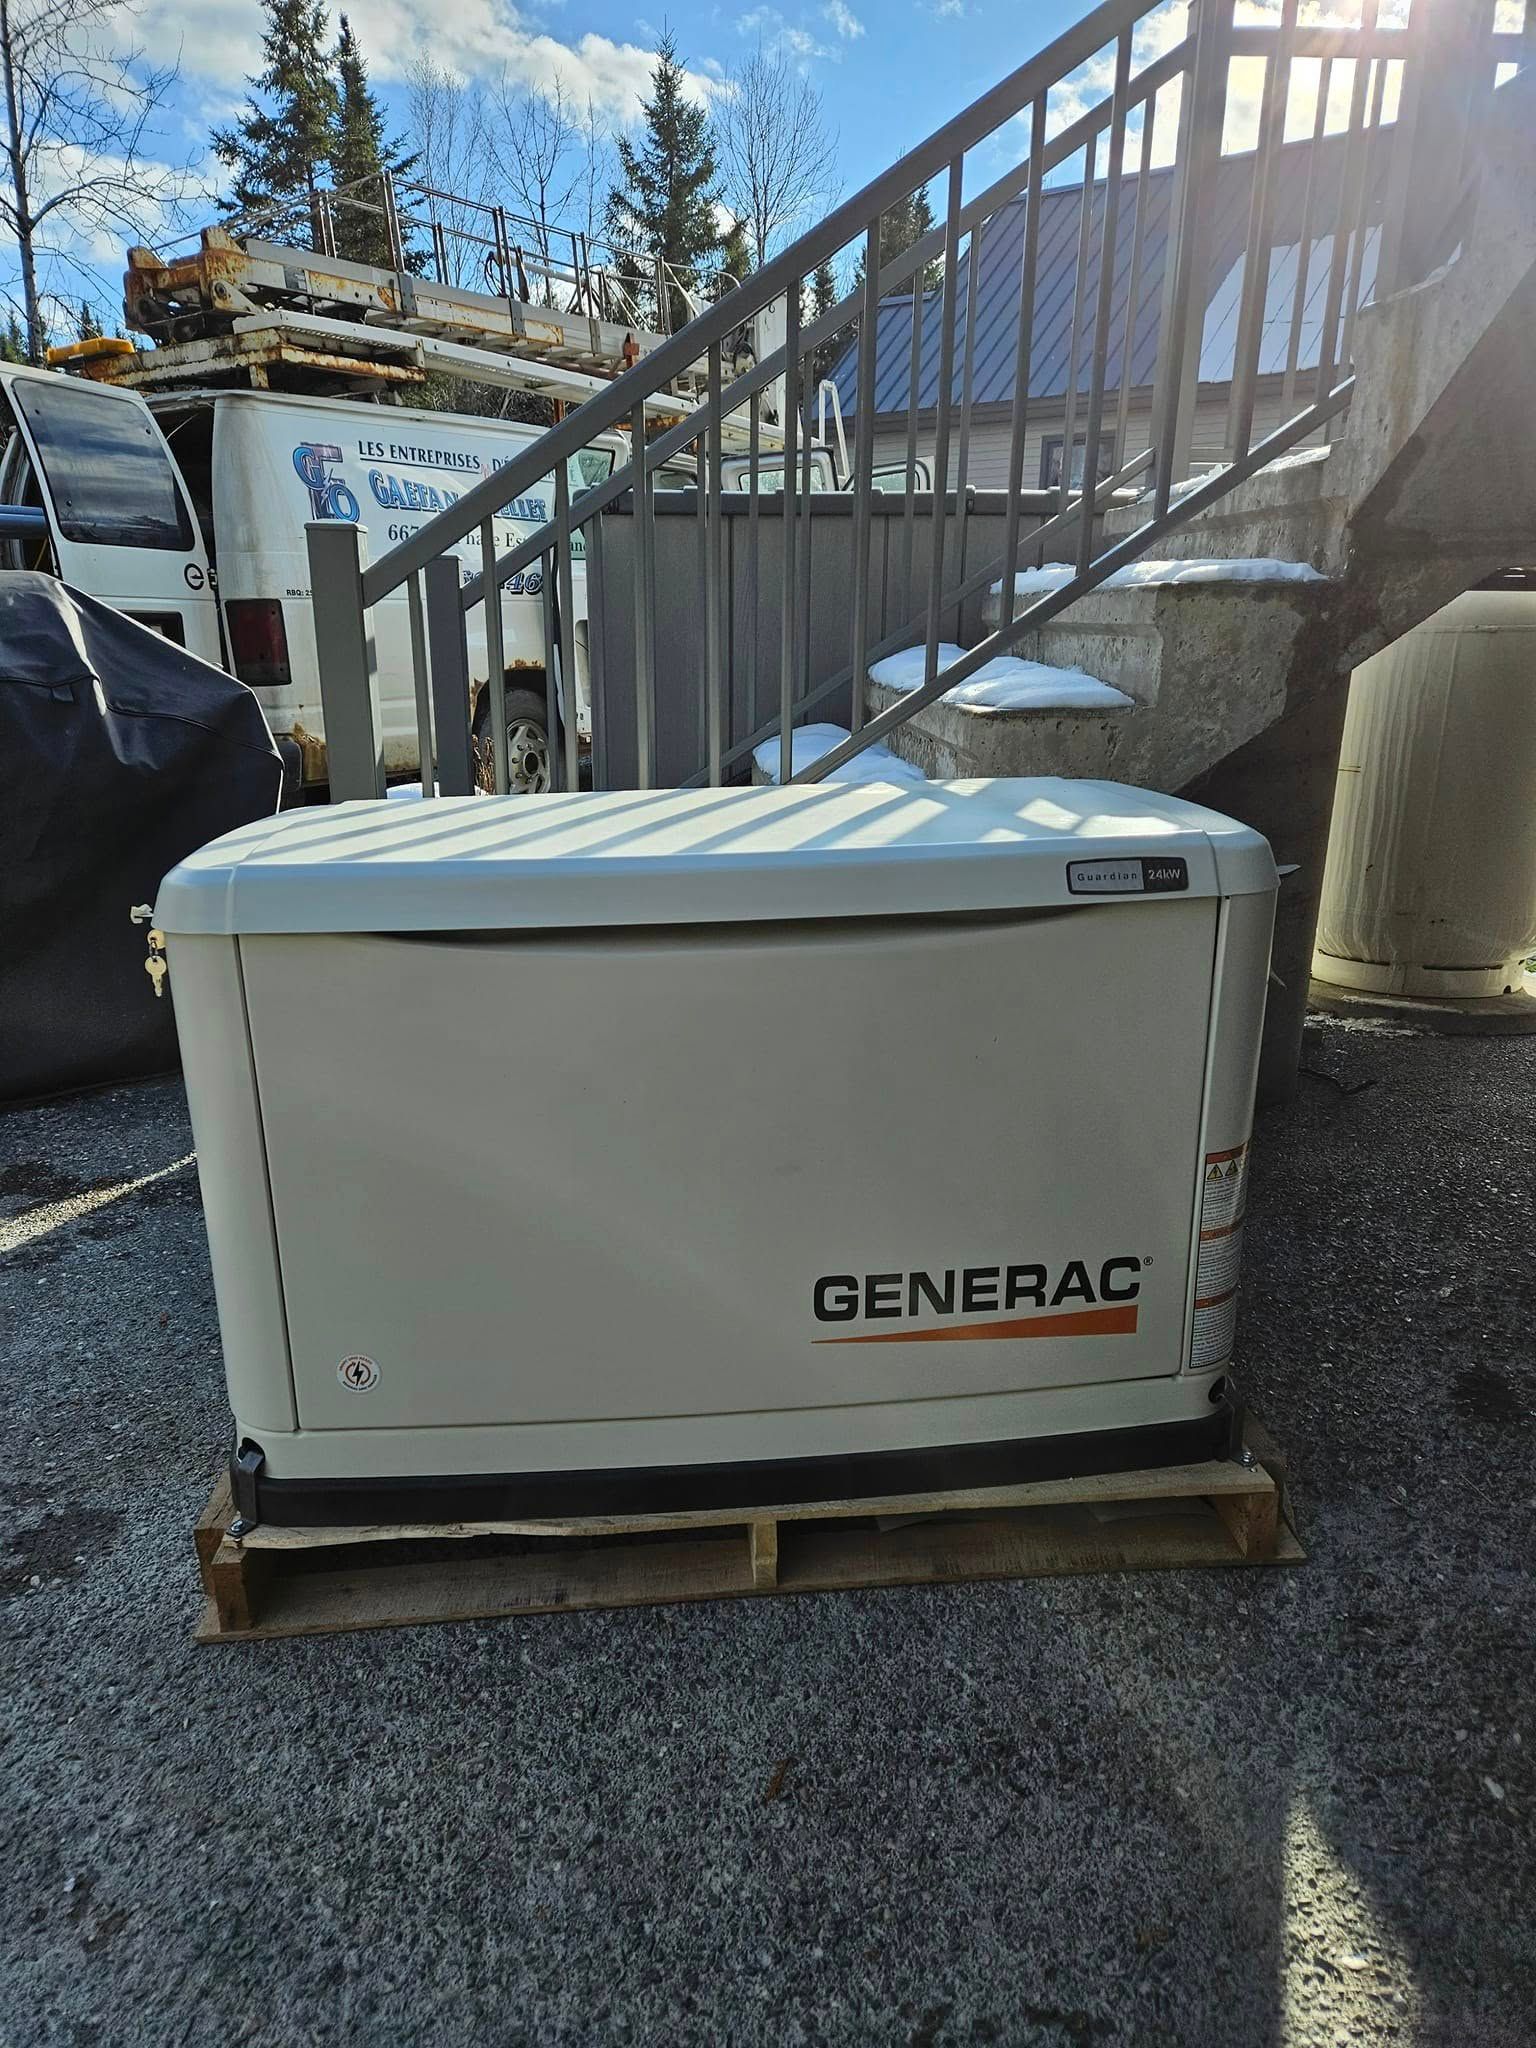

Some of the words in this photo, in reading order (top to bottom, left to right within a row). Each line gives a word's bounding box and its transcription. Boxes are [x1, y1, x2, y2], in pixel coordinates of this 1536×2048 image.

[358, 440, 384, 457] LES
[390, 444, 480, 469] ENTREPRISES
[1077, 872, 1138, 882] Guardian
[1148, 868, 1181, 880] 24kW
